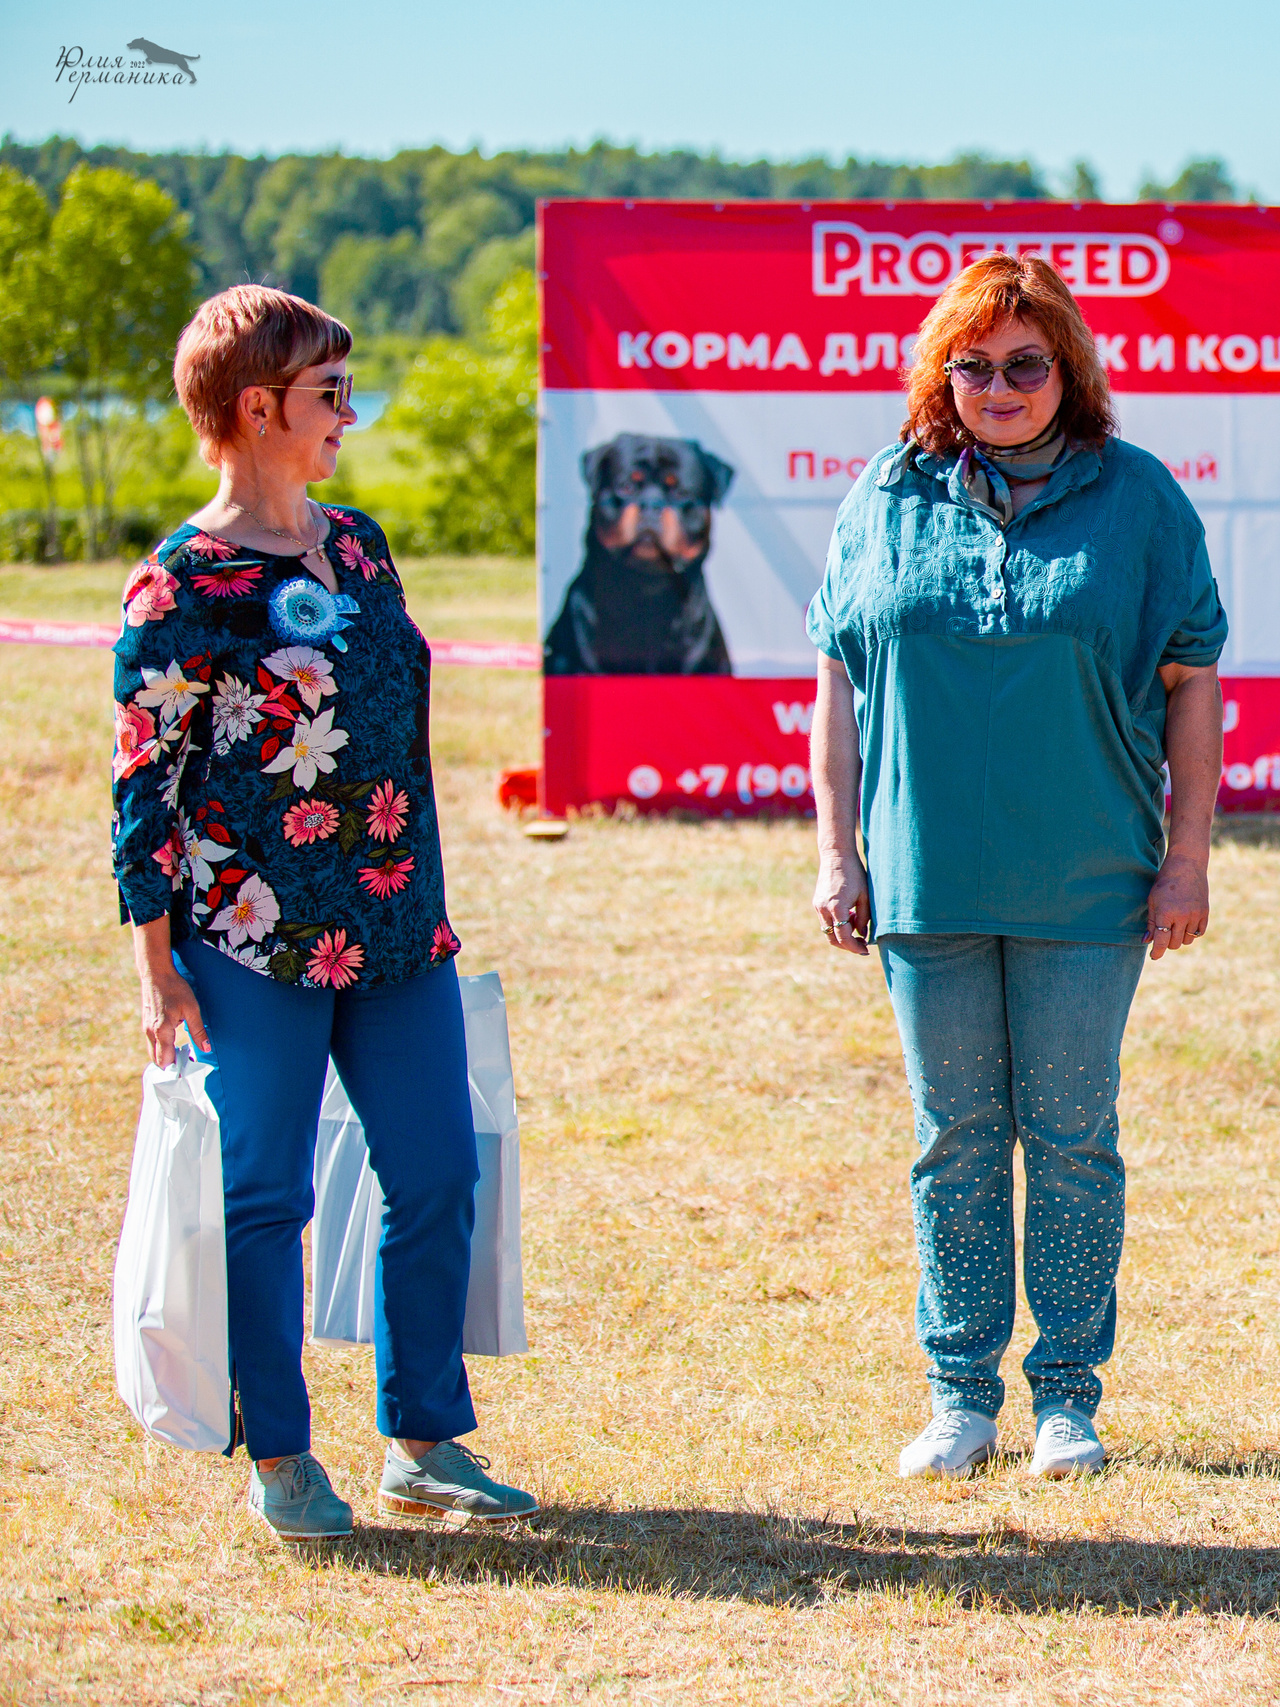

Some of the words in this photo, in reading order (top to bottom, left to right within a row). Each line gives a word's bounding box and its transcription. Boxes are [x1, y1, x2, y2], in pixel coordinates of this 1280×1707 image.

[617, 331, 812, 370] КОРМА
[1138, 333, 1175, 372] И
[676, 764, 729, 798] +7
